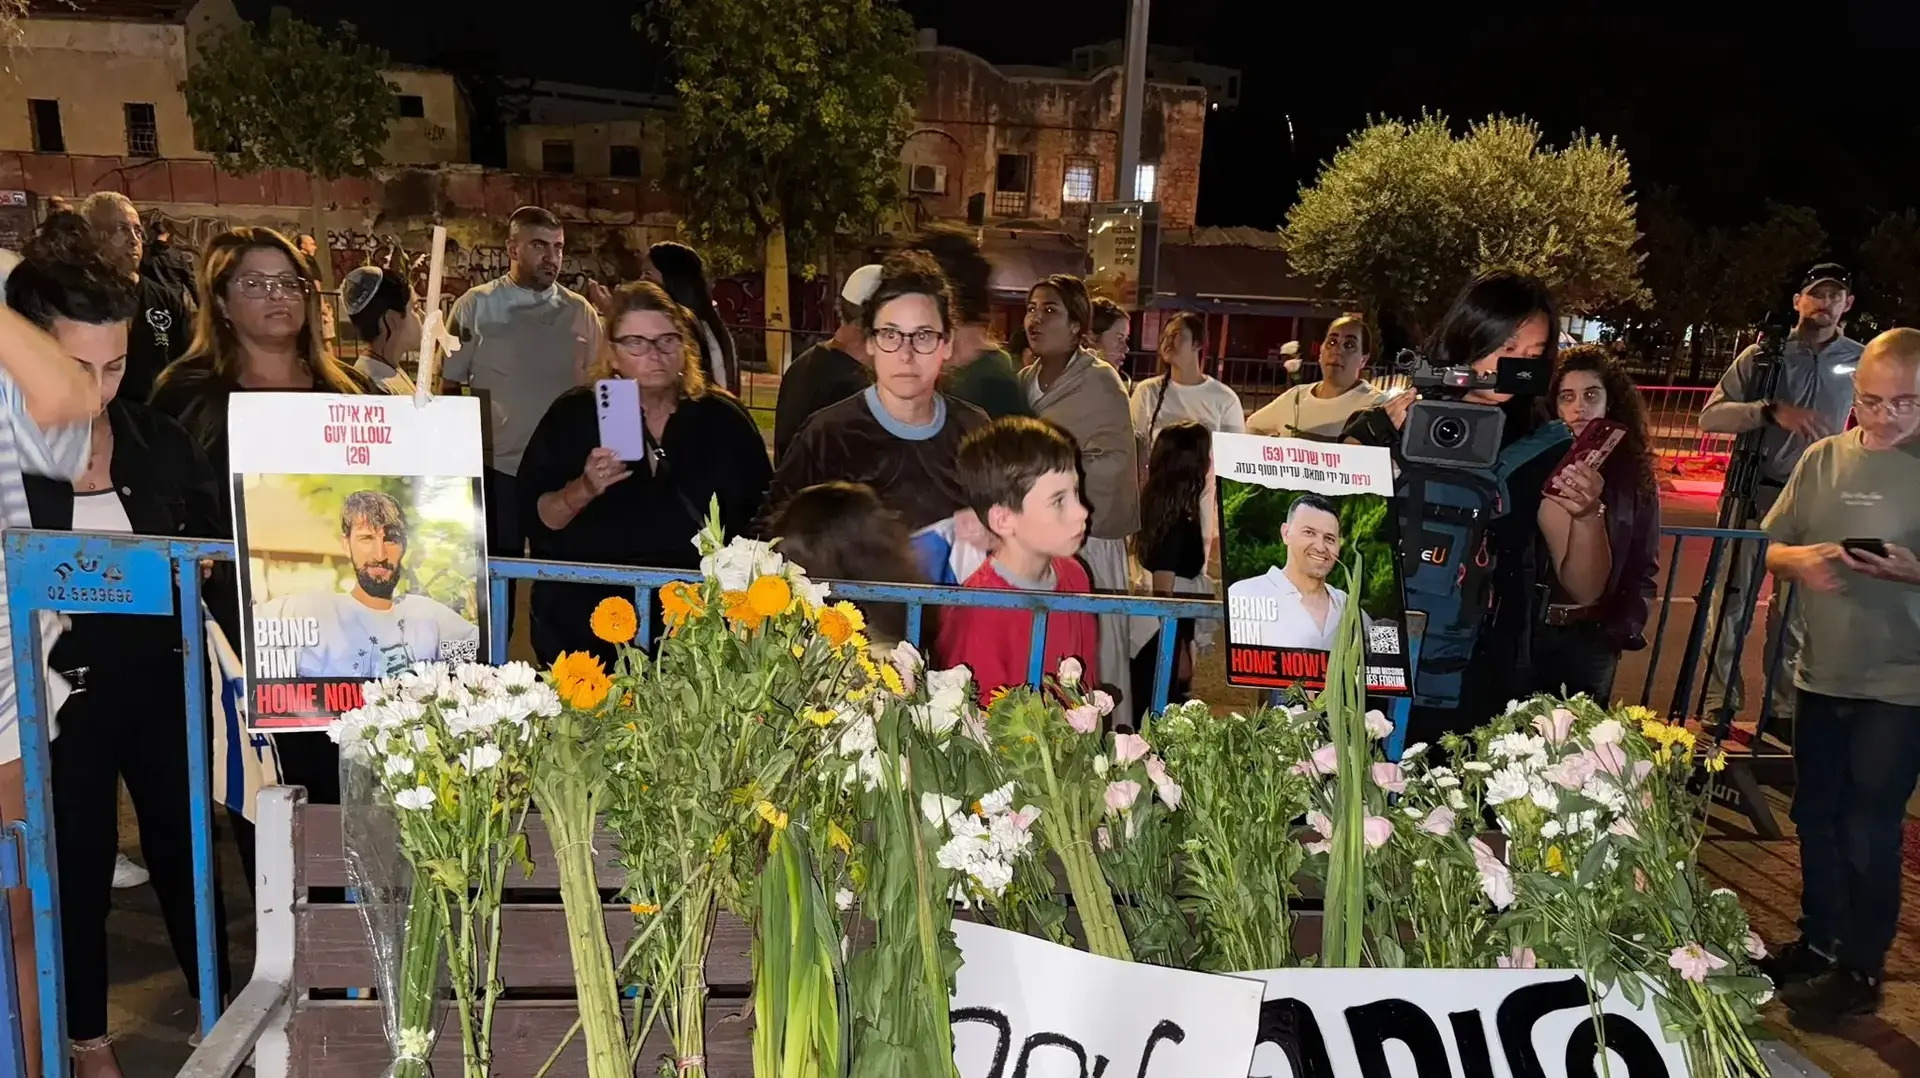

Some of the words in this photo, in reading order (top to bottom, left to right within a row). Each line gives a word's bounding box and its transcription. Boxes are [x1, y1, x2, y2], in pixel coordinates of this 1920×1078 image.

[328, 404, 360, 422] אילוז
[364, 405, 385, 423] גיא
[324, 425, 346, 443] GUY
[351, 426, 392, 444] ILLOUZ
[346, 445, 370, 466] (26)
[1263, 446, 1284, 463] (53)
[1287, 448, 1319, 465] שרעבי
[1321, 453, 1340, 468] יוסי
[1258, 464, 1277, 476] חטוף
[1280, 465, 1300, 477] עדיין
[1326, 471, 1337, 483] ידי
[1340, 472, 1350, 485] על
[1351, 473, 1371, 486] נרצח
[1230, 596, 1279, 622] BRING
[254, 617, 320, 648] BRING
[1230, 621, 1262, 645] HIM
[255, 648, 298, 679] HIM
[1231, 648, 1277, 674] HOME
[1281, 652, 1328, 679] NOW!
[1379, 675, 1406, 687] FORUM
[256, 683, 318, 713] HOME
